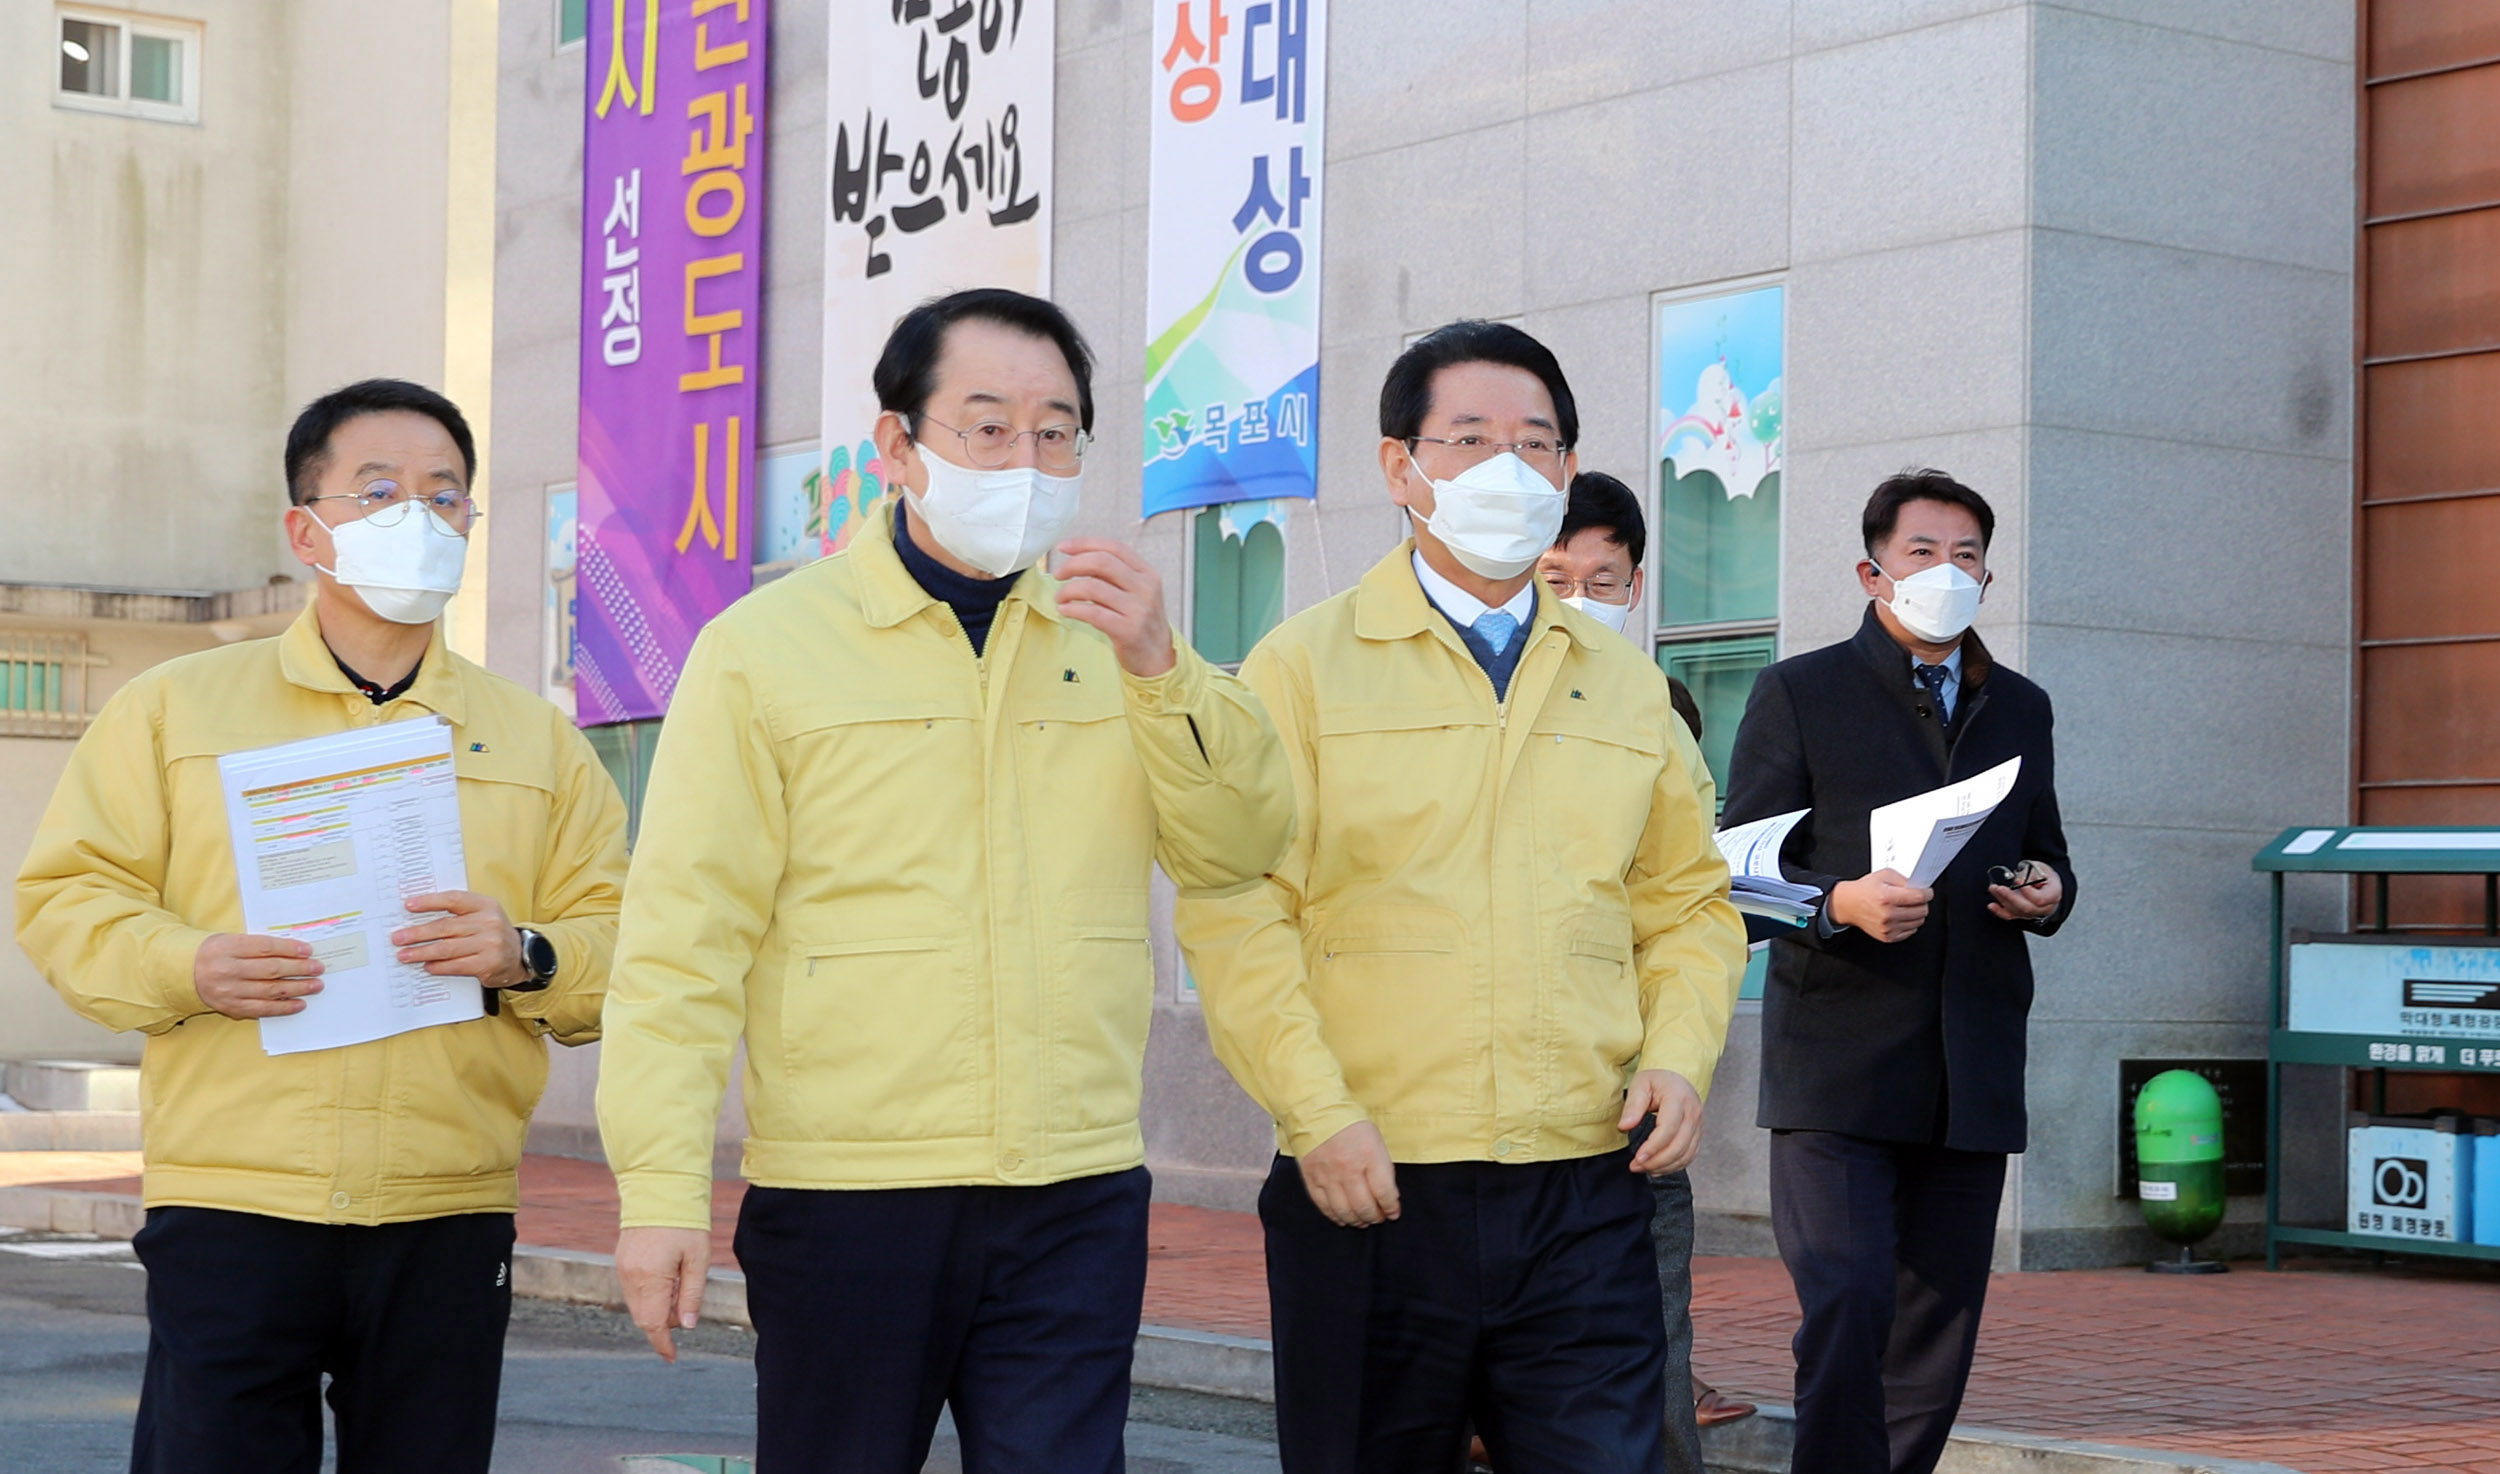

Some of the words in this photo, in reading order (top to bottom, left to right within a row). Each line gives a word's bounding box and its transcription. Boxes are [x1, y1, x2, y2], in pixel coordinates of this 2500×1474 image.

[1161, 0, 1229, 123] 상
[1232, 0, 1311, 293] 대상
[601, 168, 642, 366] 선정
[832, 103, 1040, 279] 받으세요
[1203, 393, 1308, 453] 목포시
